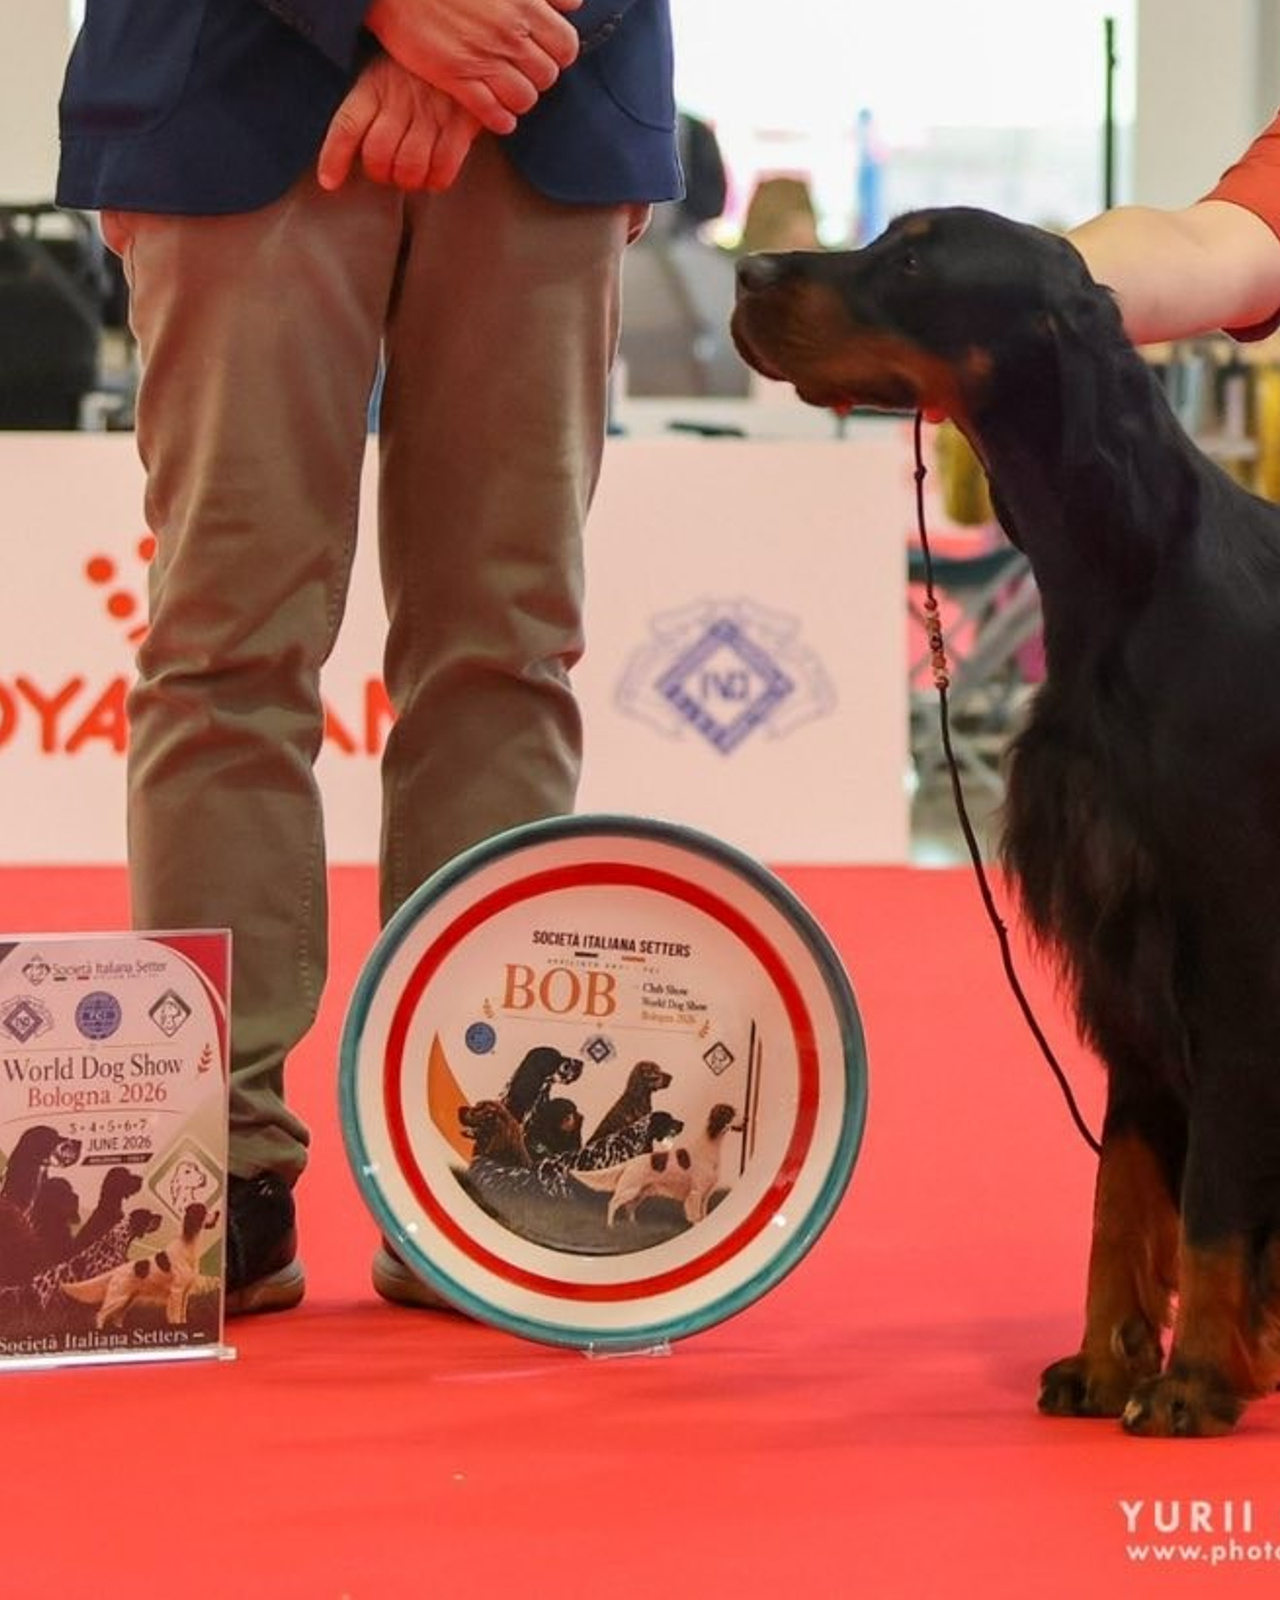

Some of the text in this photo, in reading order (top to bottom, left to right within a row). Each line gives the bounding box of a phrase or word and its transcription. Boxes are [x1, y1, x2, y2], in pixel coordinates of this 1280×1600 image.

[532, 929, 692, 958] SOCIETÀ ITALIANA SETTERS
[51, 960, 93, 976] Società
[95, 961, 134, 975] Italiana
[501, 963, 617, 1018] BOB
[4, 1053, 183, 1083] World Dog Show
[28, 1081, 168, 1111] Bologna 2026
[87, 1135, 152, 1152] JUNE 2026
[0, 1328, 189, 1352] Società Italiana Setters
